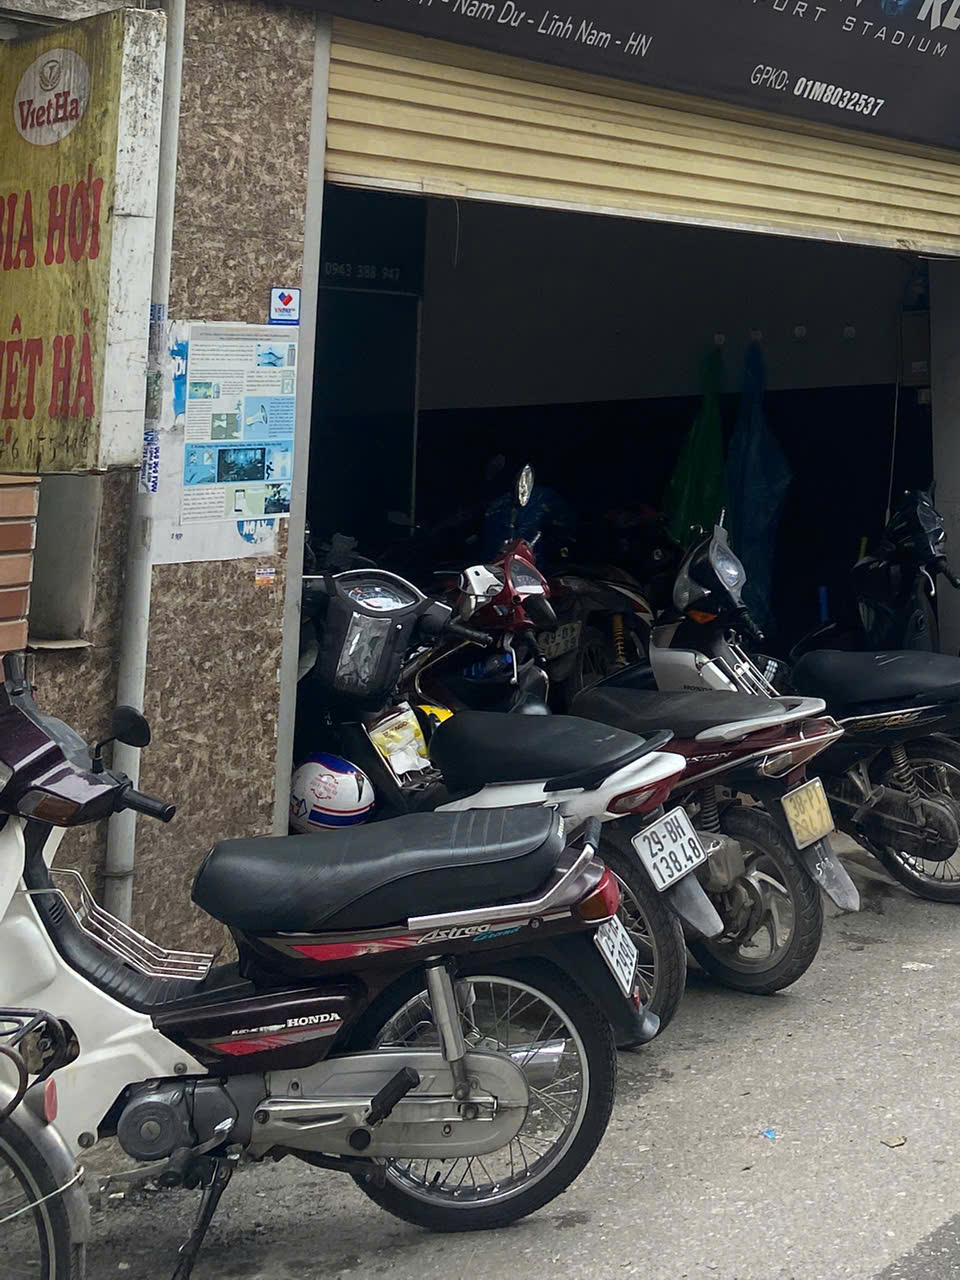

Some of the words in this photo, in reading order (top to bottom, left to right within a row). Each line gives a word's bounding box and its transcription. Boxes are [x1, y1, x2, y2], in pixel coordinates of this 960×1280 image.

[498, 0, 528, 27] Dư
[537, 7, 573, 41] Lĩnh
[575, 21, 612, 49] Nam
[625, 33, 653, 58] HN
[841, 15, 949, 58] STADIUM
[750, 64, 790, 92] GPKD:
[793, 76, 885, 117] 01M8032537
[44, 162, 104, 265] HƠI
[48, 307, 95, 418] HÀ
[642, 815, 687, 859] 29-BH
[652, 837, 702, 885] 138.48
[416, 923, 491, 945] Astrea
[287, 1011, 342, 1029] HONDA
